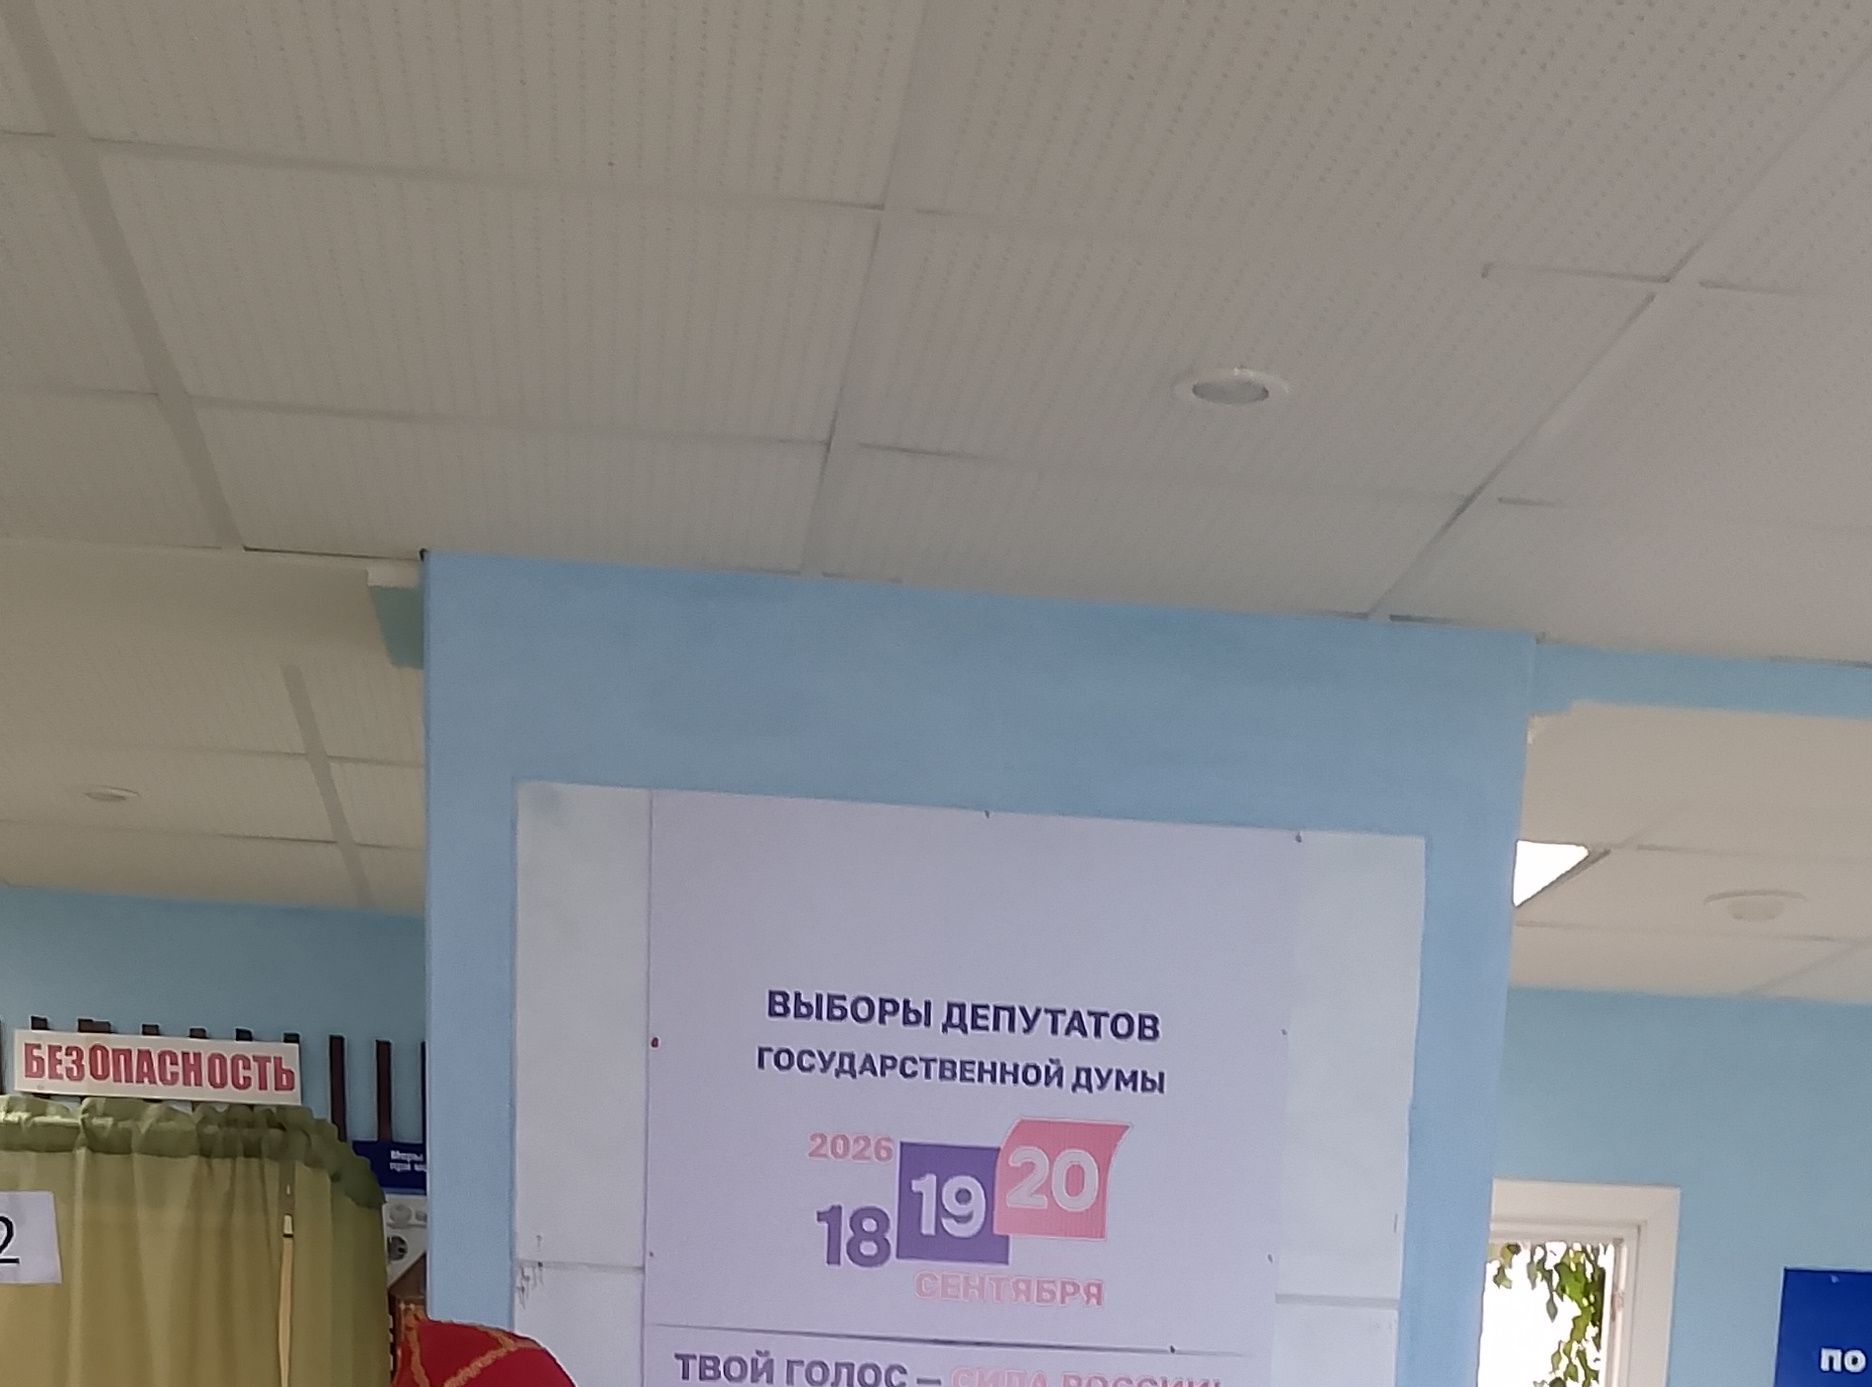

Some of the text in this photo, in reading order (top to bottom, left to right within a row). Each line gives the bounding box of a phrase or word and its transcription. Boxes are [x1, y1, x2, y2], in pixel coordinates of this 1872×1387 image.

[767, 990, 1161, 1041] ВЫБОРЫ ДЕПУТАТОВ
[24, 1042, 295, 1091] БЕЗОПАСНОСТЬ
[757, 1047, 1165, 1094] ГОСУДАРСТВЕННОЙ ДУМЫ
[808, 1133, 893, 1162] 2026
[816, 1146, 1098, 1268] 18 19 20
[915, 1272, 1104, 1307] СЕНТЯБРЯ
[674, 1350, 774, 1385] ТВОЙ
